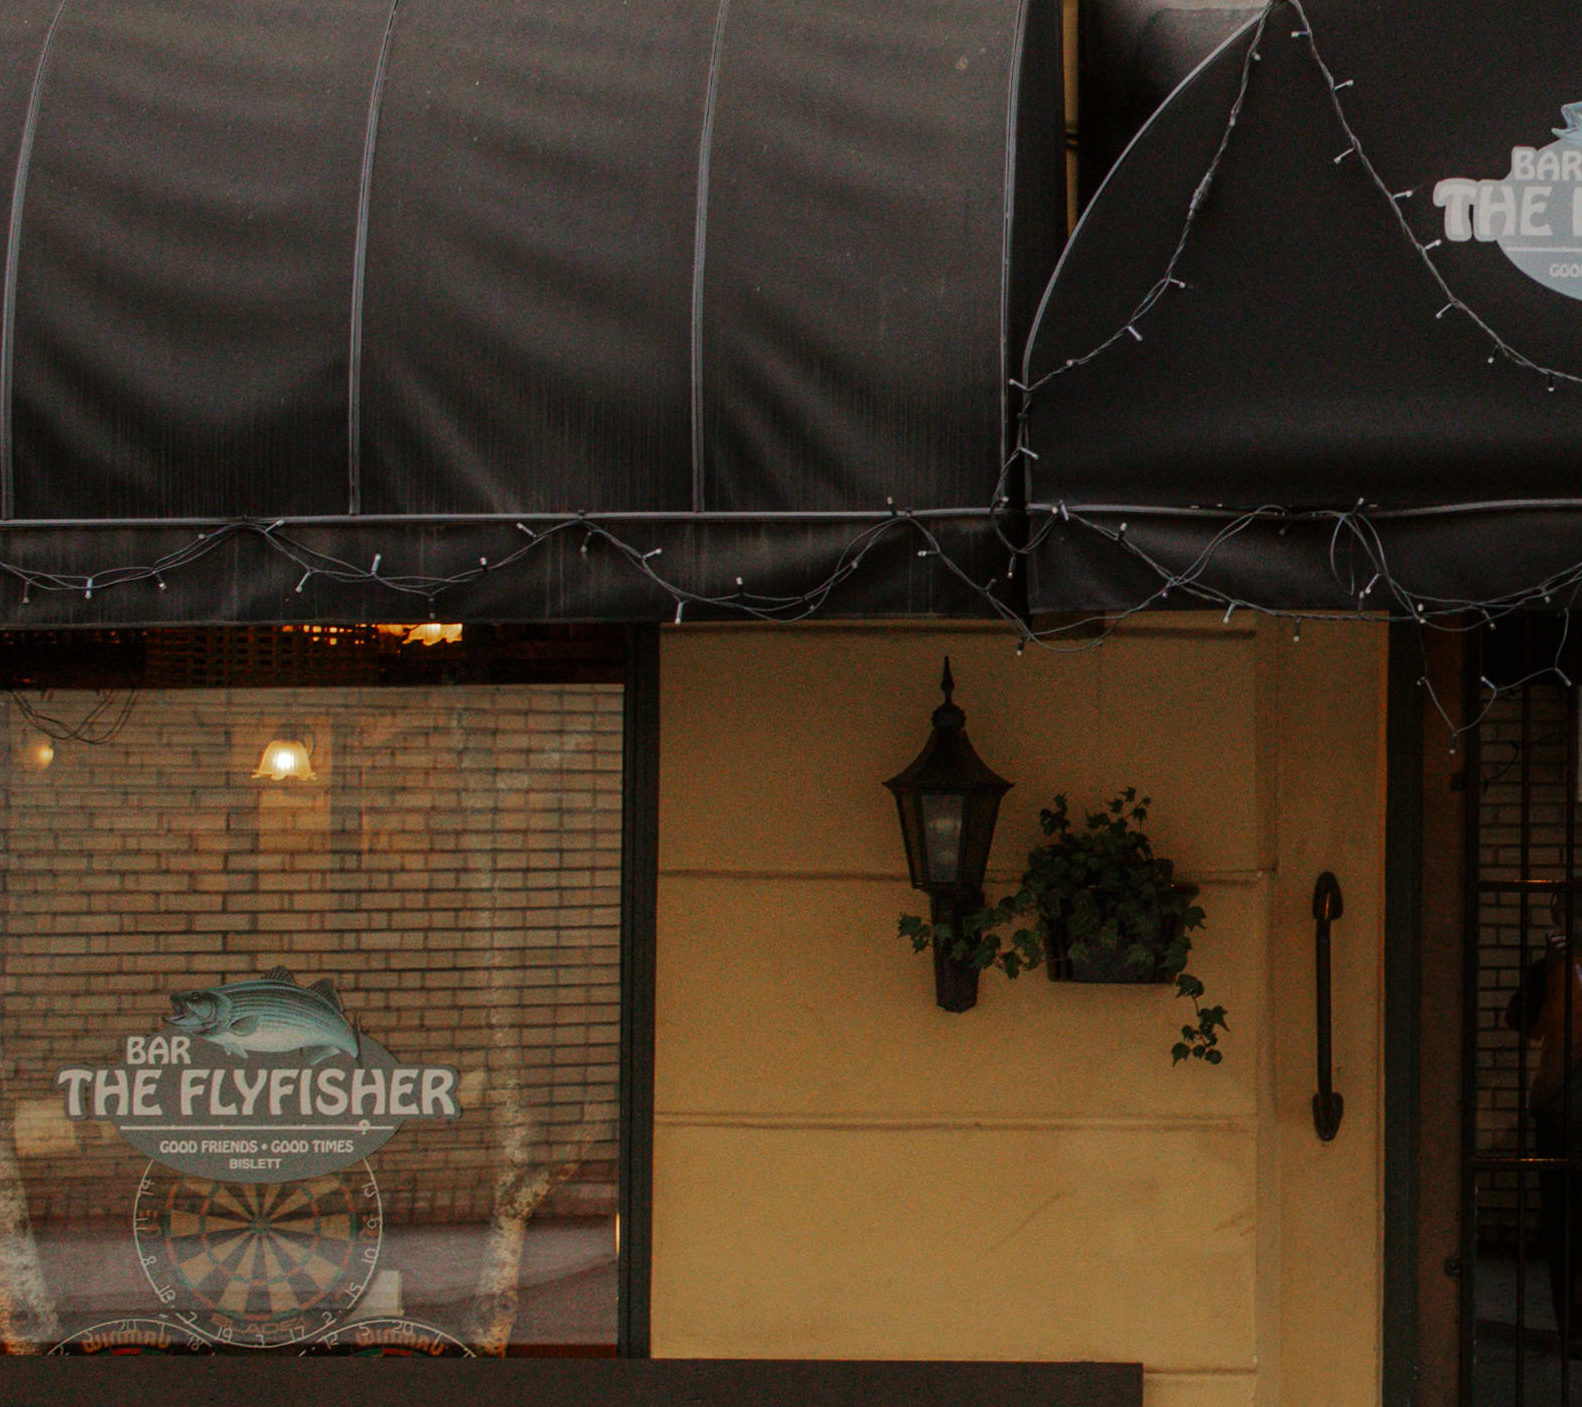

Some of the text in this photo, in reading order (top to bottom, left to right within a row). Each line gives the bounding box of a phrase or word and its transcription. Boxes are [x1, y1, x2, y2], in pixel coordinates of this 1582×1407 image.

[1436, 185, 1553, 237] THE
[126, 1036, 192, 1064] BAR
[58, 1069, 457, 1116] THE FLYFISHER
[159, 1140, 354, 1154] GOOD FRIENDS GOOD TIMES
[229, 1158, 283, 1170] BISLETT
